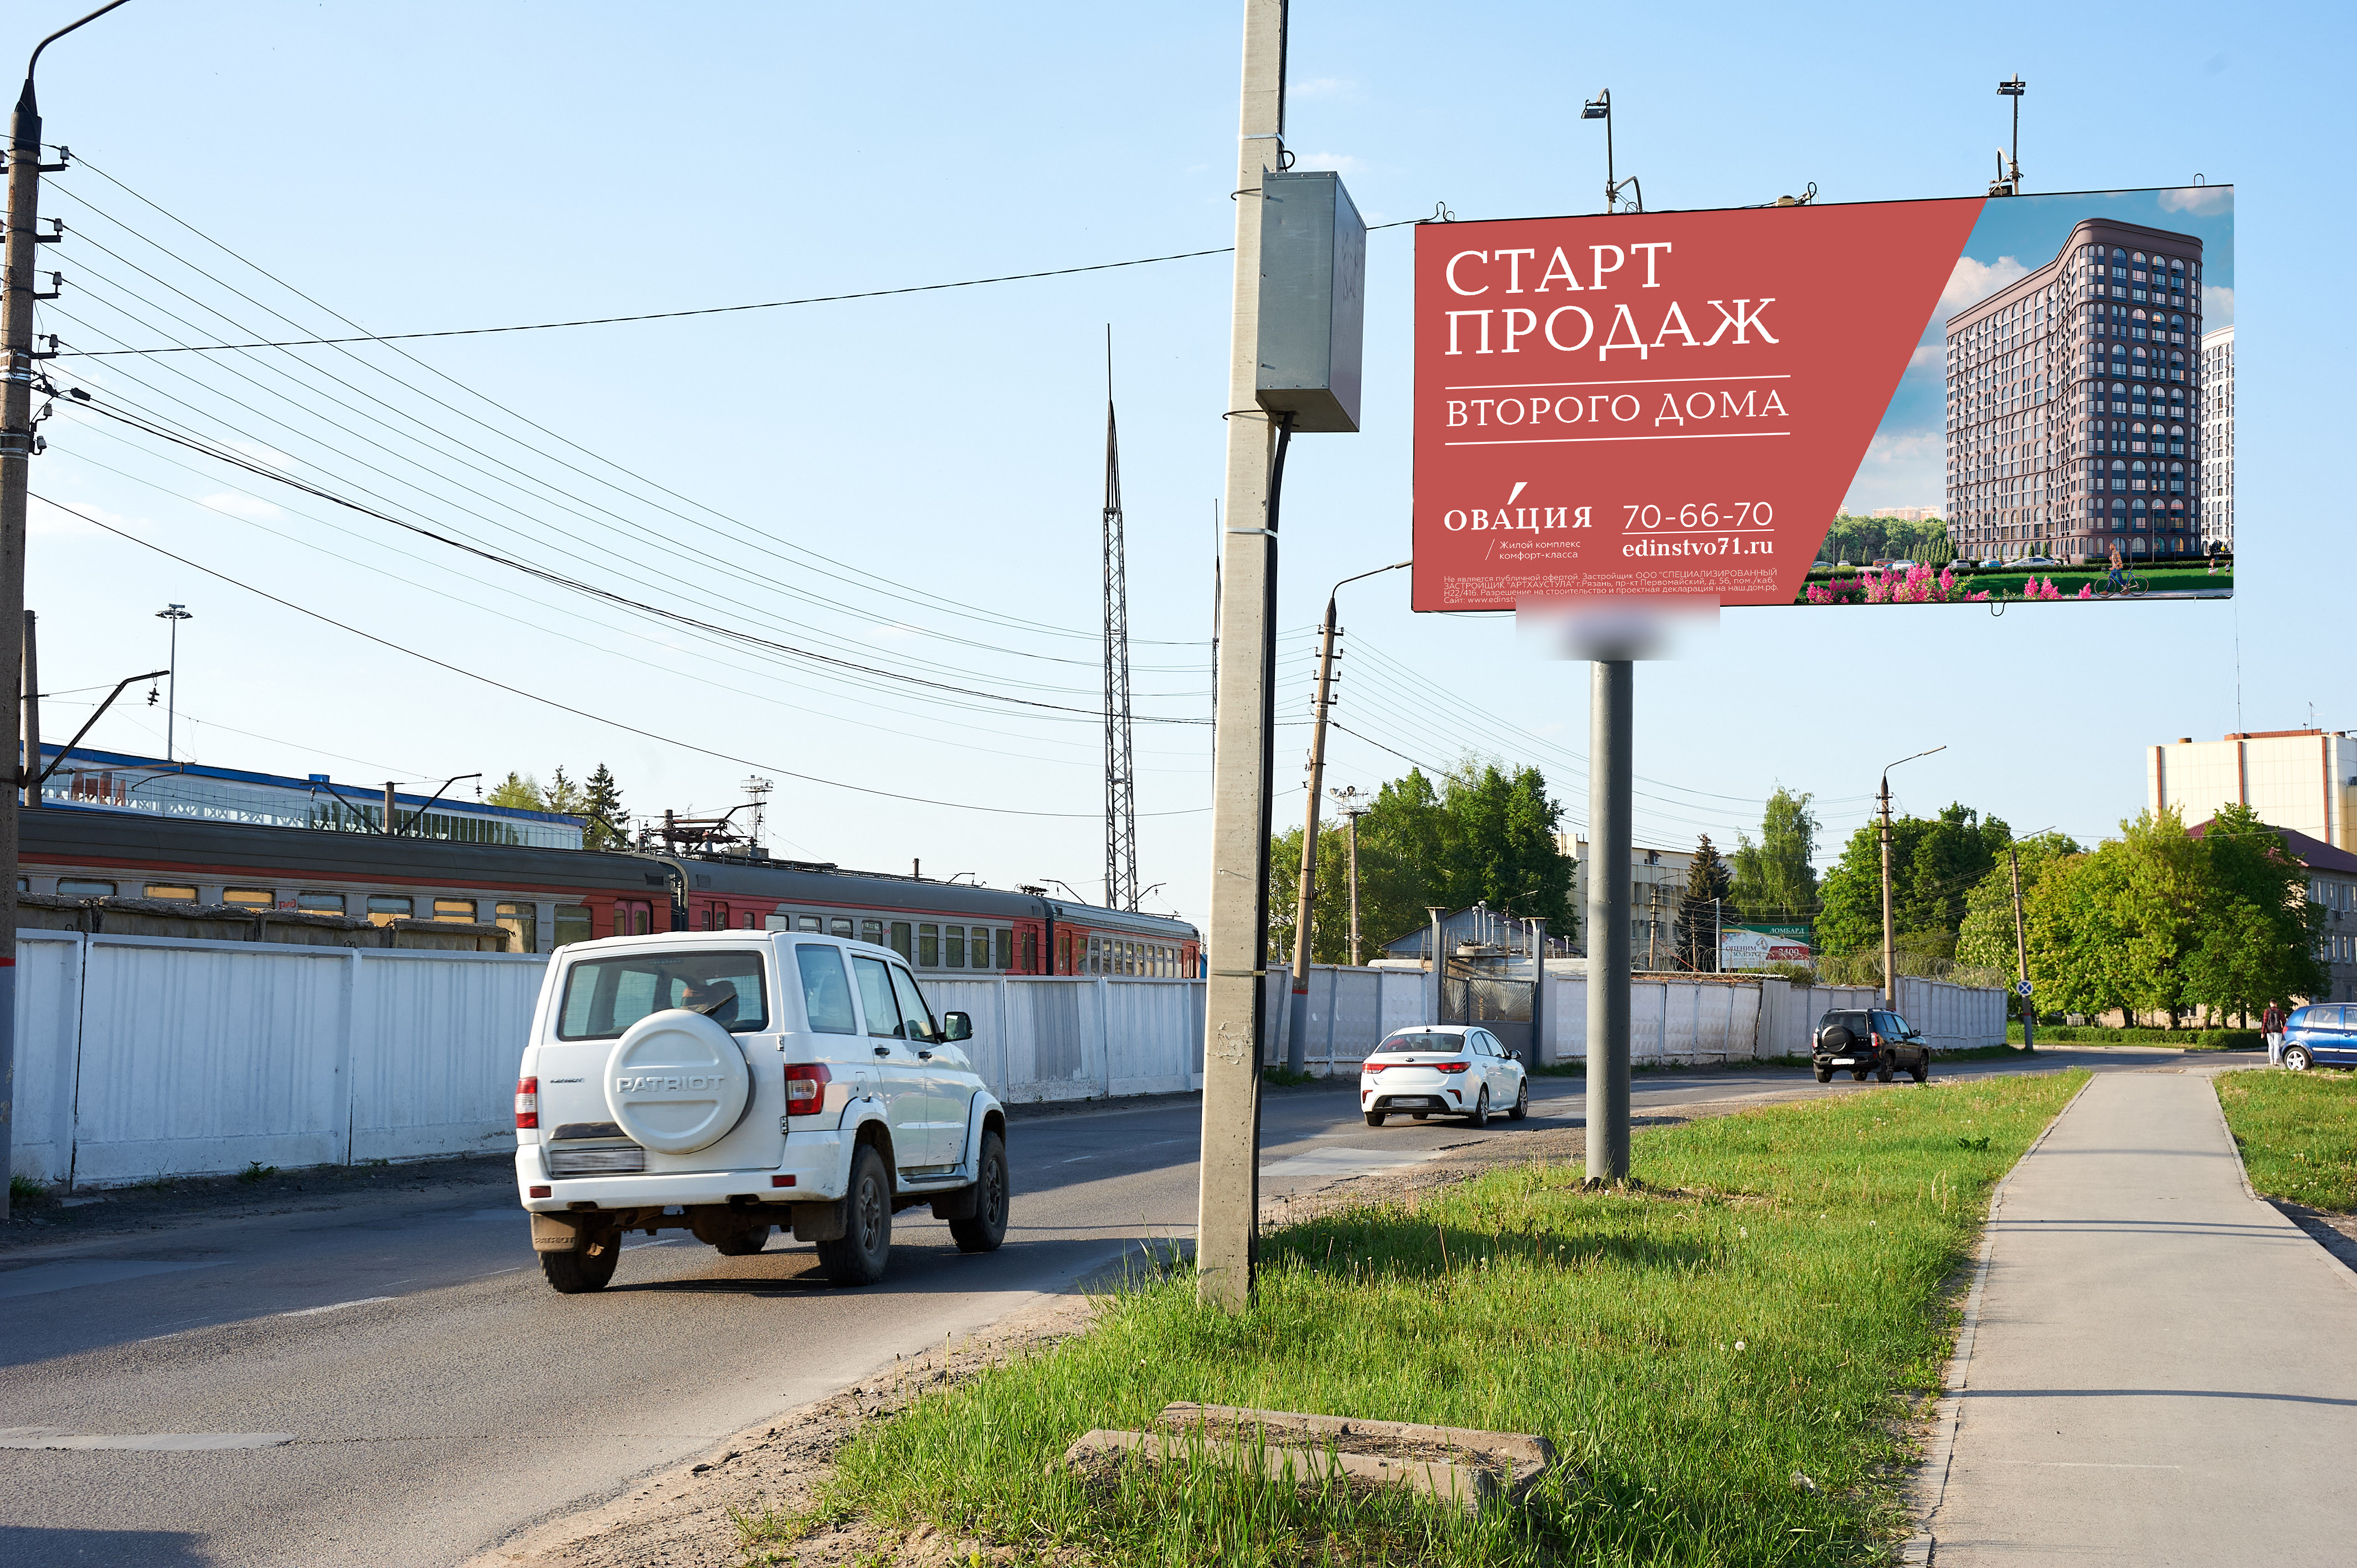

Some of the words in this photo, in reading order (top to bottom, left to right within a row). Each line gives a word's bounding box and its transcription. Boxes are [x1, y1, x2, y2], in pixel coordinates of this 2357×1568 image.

[1445, 242, 1672, 296] СТАРТ
[1445, 298, 1779, 362] ПРОДАЖ
[1446, 394, 1640, 427] ВТОРОГО
[1655, 389, 1789, 427] ДОМА
[1623, 502, 1773, 529] 70-66-70
[1500, 540, 1533, 549] Жилой
[1623, 538, 1774, 558] edinstvo71.ru
[1500, 551, 1578, 561] комфорт-класса
[1444, 581, 1505, 590] ЗАСТРОЙЩИК
[1507, 580, 1574, 589] "АРТХАУСТУЛА"
[1640, 578, 1706, 586] Первомайский,
[1496, 574, 1540, 583] публичной
[1542, 574, 1579, 582] офертой.
[1582, 572, 1633, 581] Застройщик
[1659, 568, 1777, 579] "СПЕЦИАЛИЗИРОВАННЫЙ
[1481, 589, 1531, 597] Разрешение
[616, 1075, 725, 1092] PATRIOT
